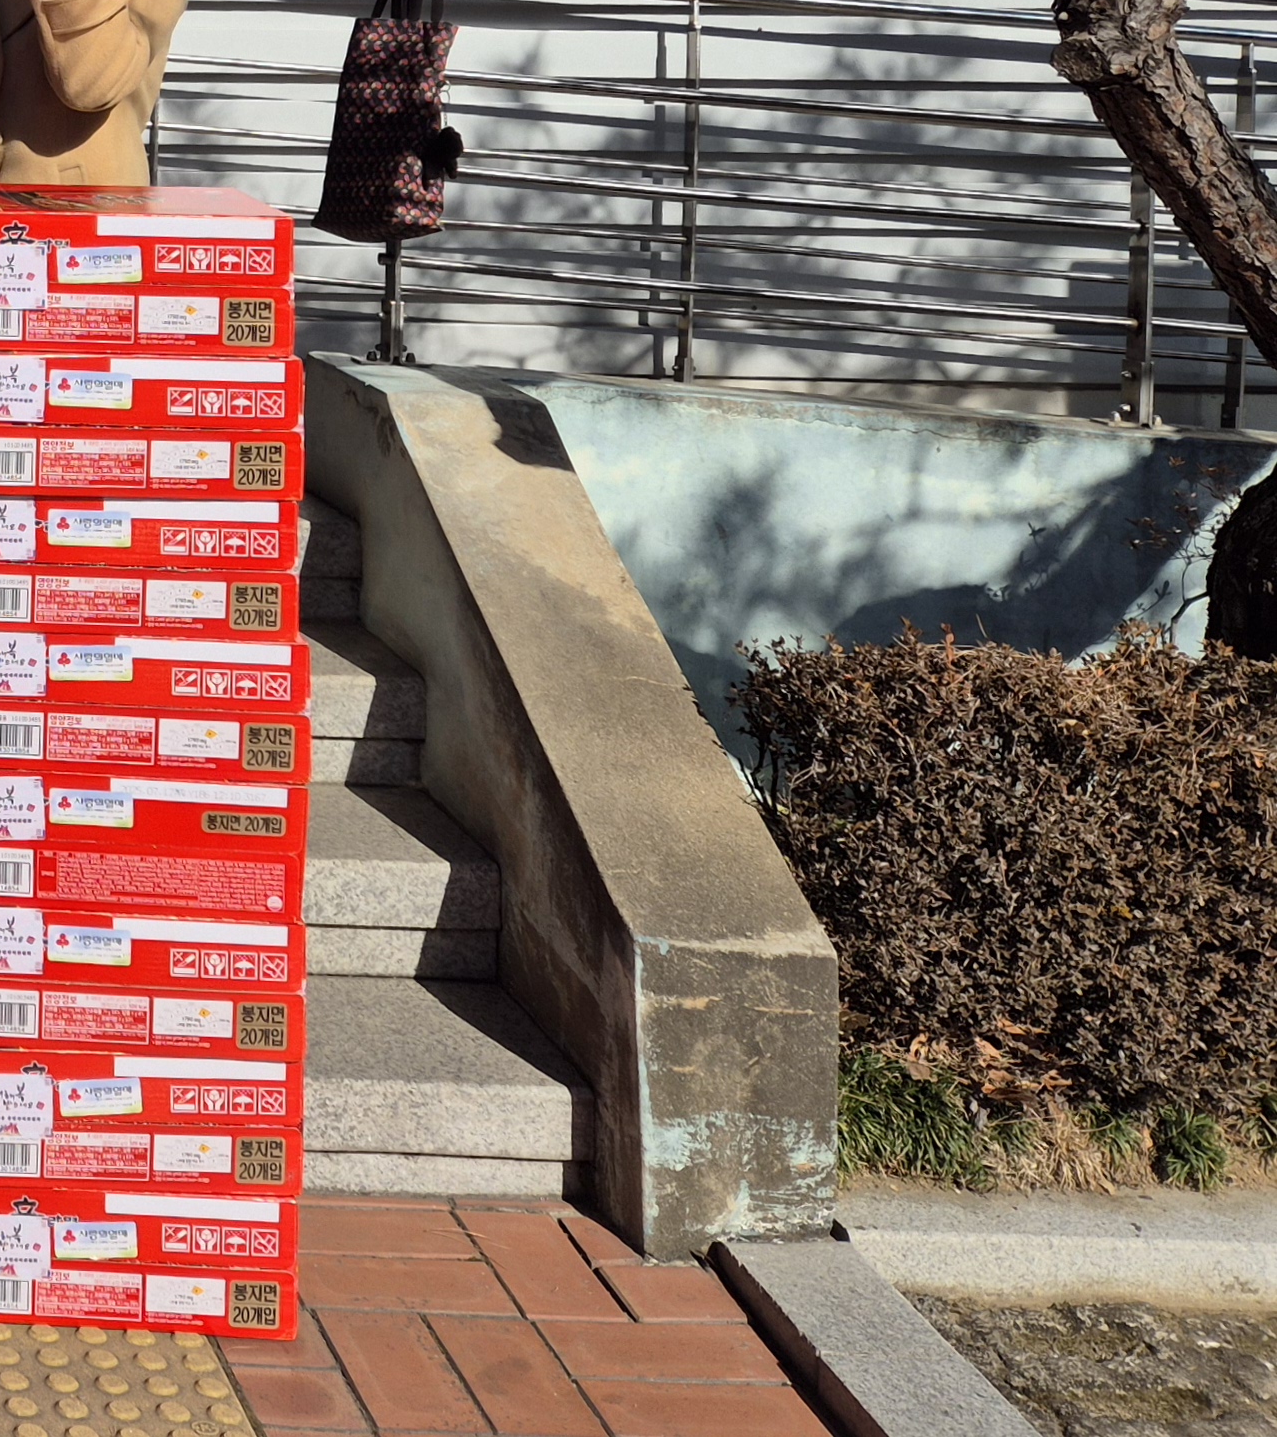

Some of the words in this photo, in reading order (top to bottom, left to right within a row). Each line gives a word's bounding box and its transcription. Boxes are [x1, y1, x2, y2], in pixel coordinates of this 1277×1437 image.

[227, 301, 272, 320] 봉지면
[226, 324, 271, 343] 20개입
[239, 445, 282, 464] 봉지면
[237, 468, 281, 487] 20개입
[235, 586, 279, 605] 봉지면
[233, 608, 277, 627] 20개입
[242, 1006, 285, 1024] 봉지면
[240, 1027, 284, 1047] 20개입
[234, 1284, 277, 1303] 봉지면
[233, 1306, 276, 1326] 20개입
